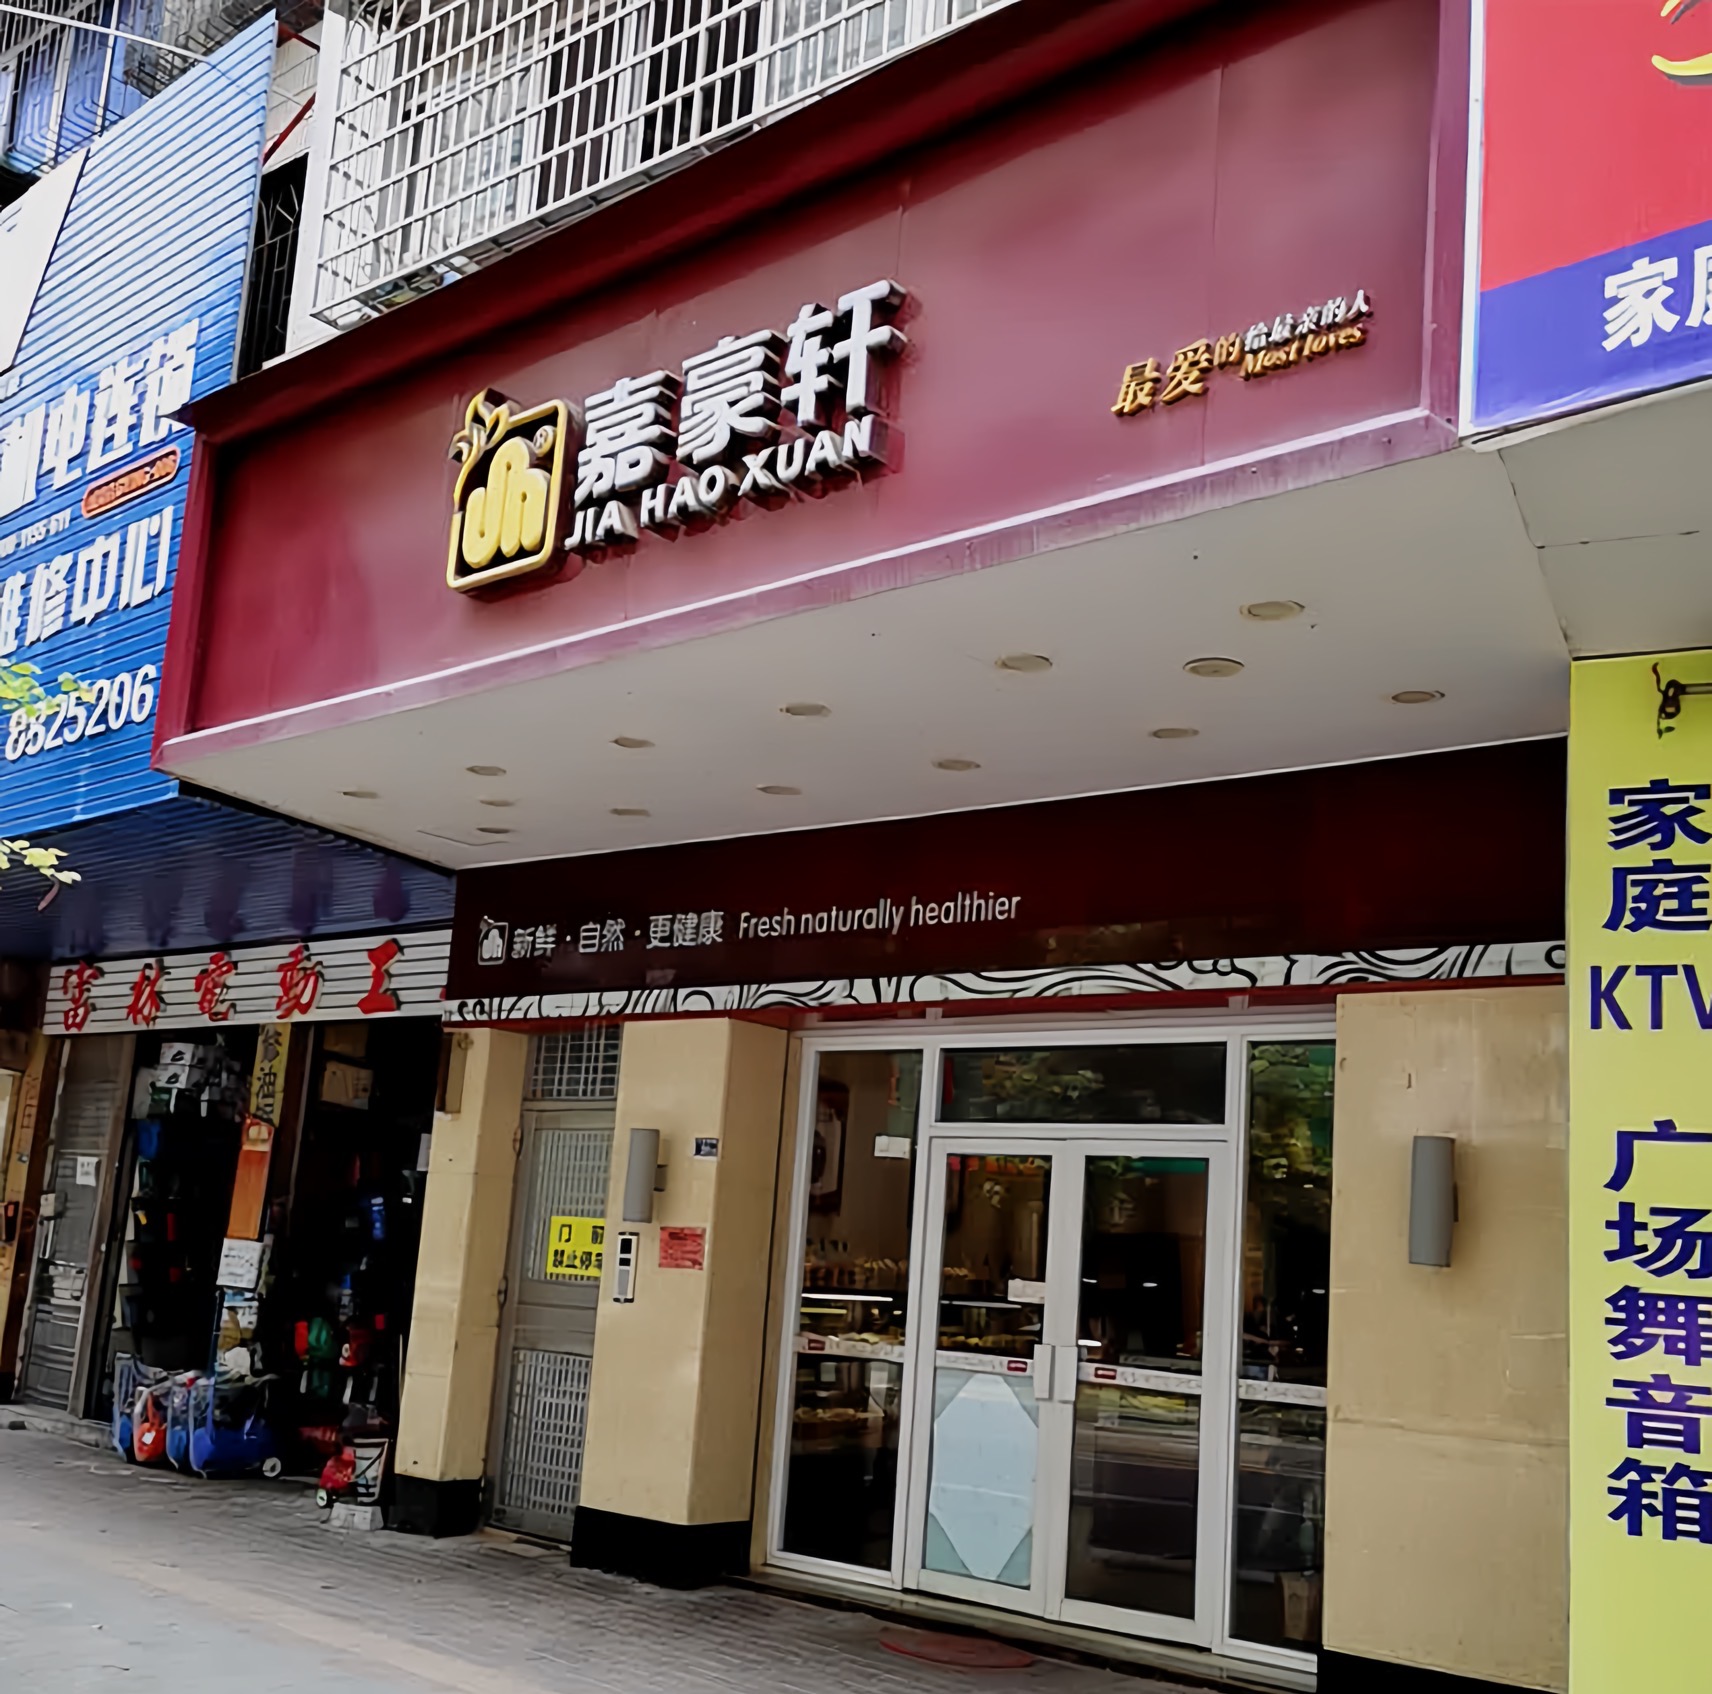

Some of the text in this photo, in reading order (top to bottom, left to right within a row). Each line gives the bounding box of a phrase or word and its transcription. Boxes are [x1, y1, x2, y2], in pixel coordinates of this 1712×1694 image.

[574, 279, 897, 506] 嘉豪轩
[1111, 332, 1244, 416] 最爱的
[564, 414, 876, 551] JIA HAO XUAN
[5, 663, 157, 761] 8825206
[738, 909, 795, 939] Fresh
[800, 898, 904, 935] naturally
[910, 891, 1021, 927] healthier
